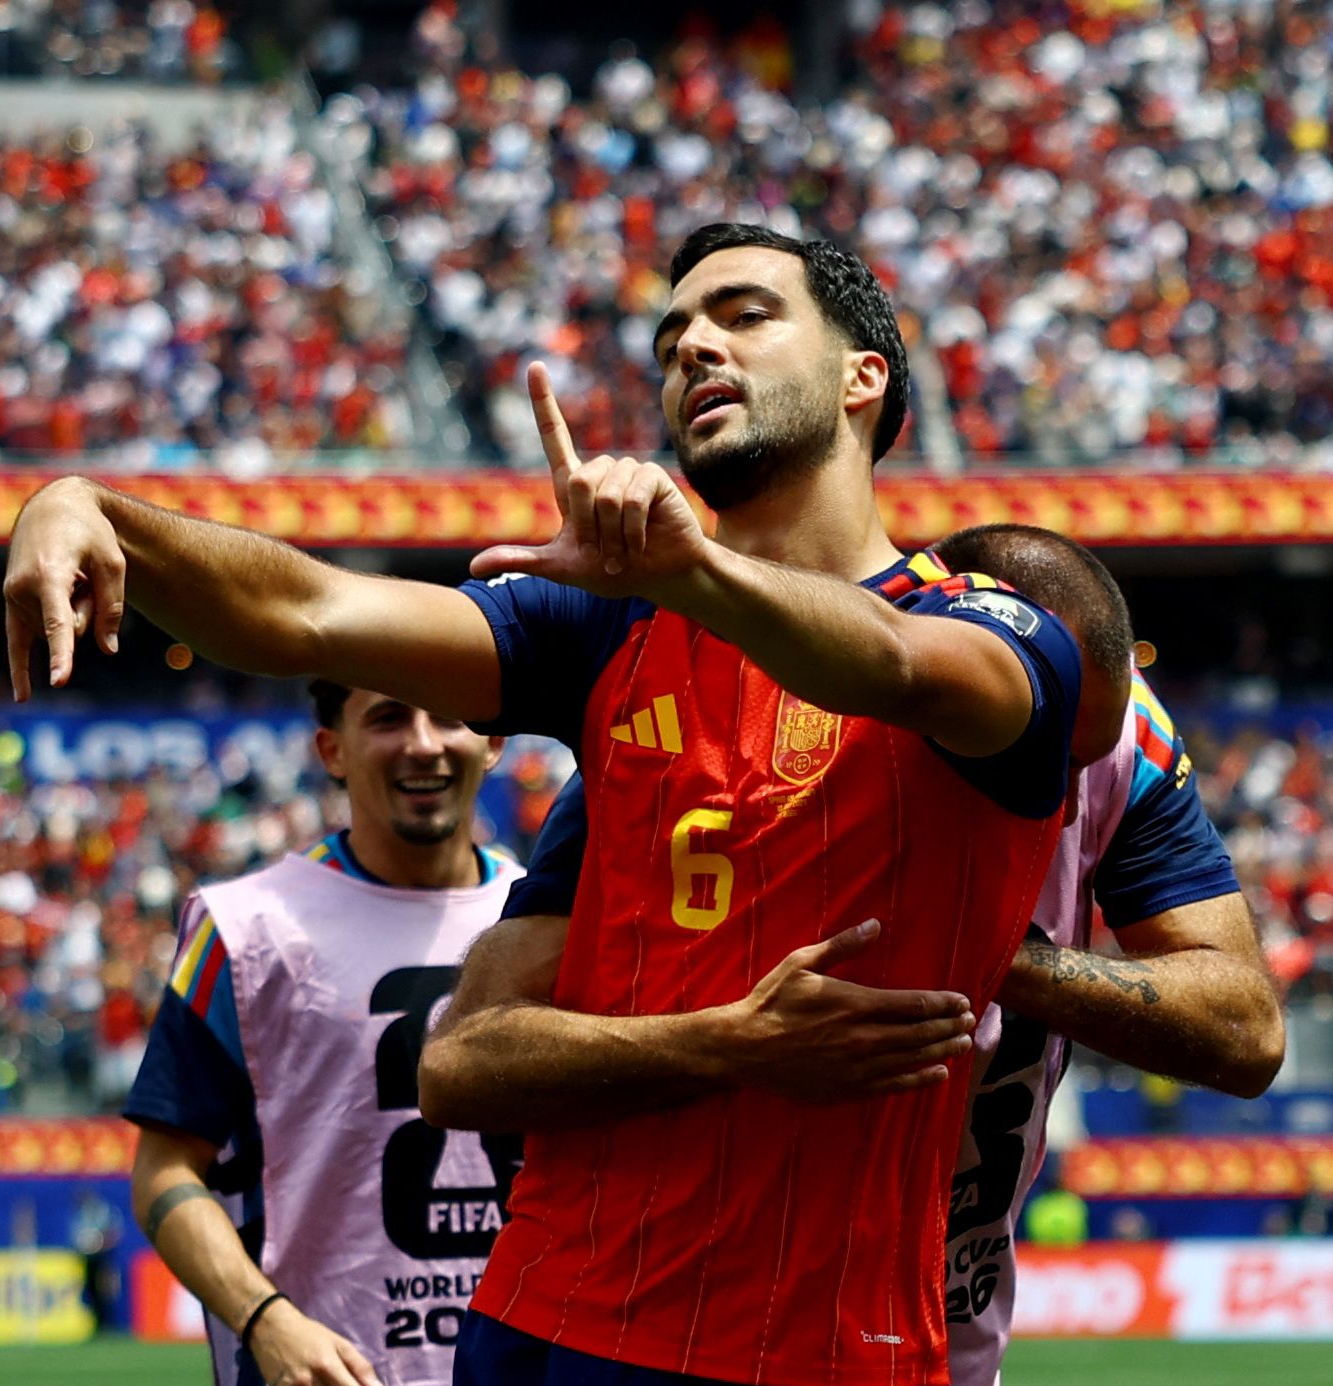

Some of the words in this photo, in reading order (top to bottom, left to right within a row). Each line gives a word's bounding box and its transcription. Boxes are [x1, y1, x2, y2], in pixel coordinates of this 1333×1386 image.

[670, 809, 735, 931] 6
[428, 1201, 503, 1234] FIFA
[954, 1234, 1010, 1274] CUP
[946, 1263, 1001, 1324] 26
